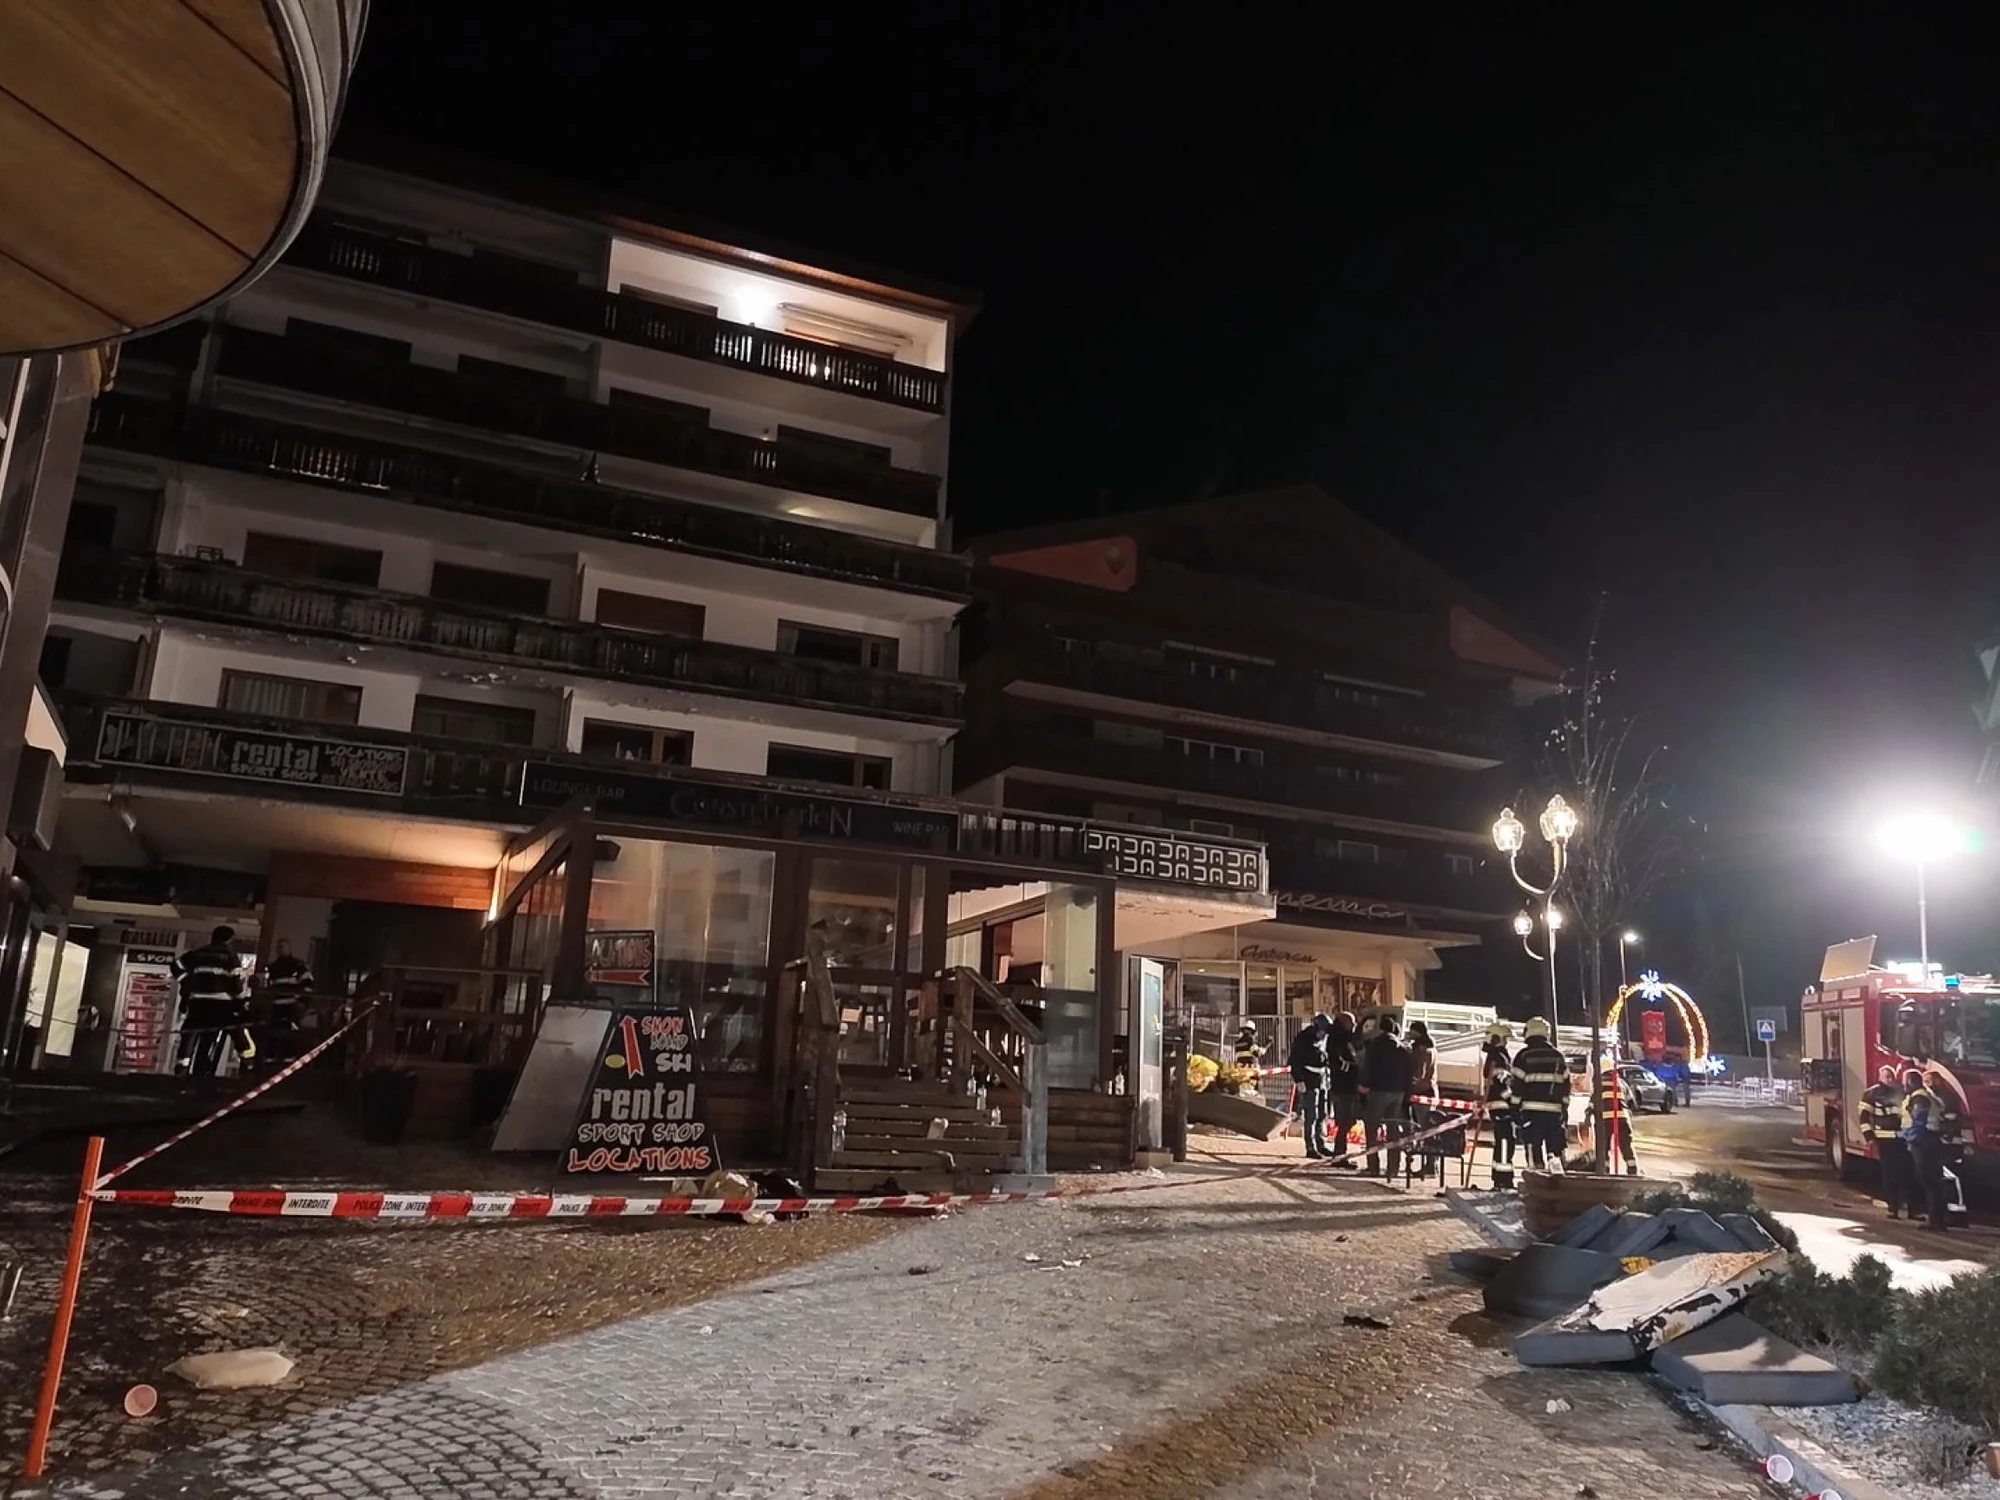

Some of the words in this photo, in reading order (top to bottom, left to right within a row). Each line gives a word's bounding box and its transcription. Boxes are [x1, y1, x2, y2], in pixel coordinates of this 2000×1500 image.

[231, 740, 320, 772] rental
[596, 785, 626, 801] BAR
[892, 820, 923, 835] WINE
[640, 1015, 685, 1038] SNOW
[655, 1052, 692, 1073] SKI
[590, 1082, 696, 1121] rental
[577, 1123, 646, 1146] SPORT
[651, 1122, 706, 1143] SHOP
[567, 1146, 712, 1173] LOCATIONS
[288, 1199, 331, 1210] INTERDITE
[352, 1199, 381, 1211] POLICE
[382, 1200, 403, 1211] ZONE
[489, 1202, 507, 1213] ZONE
